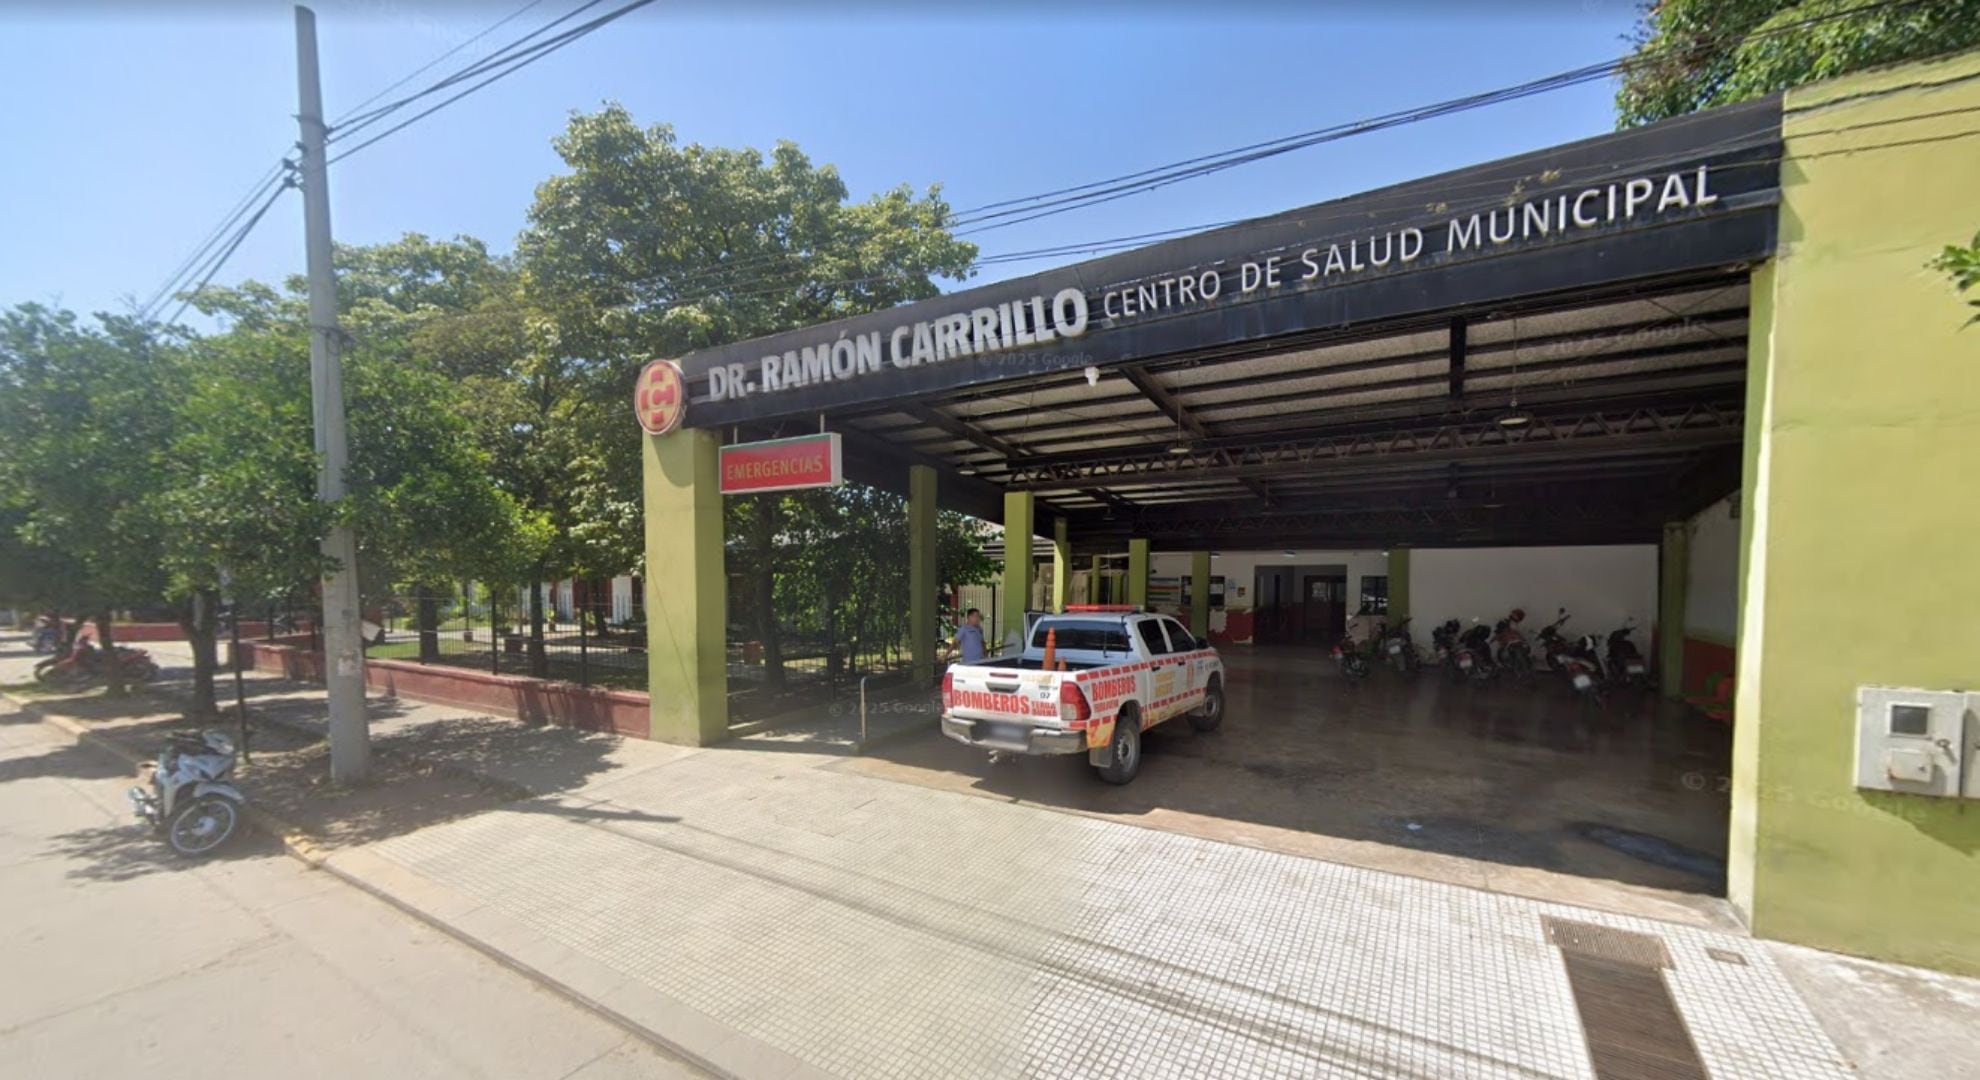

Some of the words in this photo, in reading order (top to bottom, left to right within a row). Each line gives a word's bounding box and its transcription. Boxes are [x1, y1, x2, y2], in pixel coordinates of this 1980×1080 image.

[1103, 270, 1221, 320] CENTRO
[1241, 256, 1282, 294] DE
[1301, 227, 1424, 280] SALUD
[1446, 165, 1718, 254] MUNICIPAL
[708, 363, 756, 401] DR.
[761, 329, 881, 392] RAMÓN
[726, 455, 823, 481] EMERGENCIAS
[1091, 675, 1136, 702] BOMBEROS
[953, 690, 1030, 715] BOMBEROS
